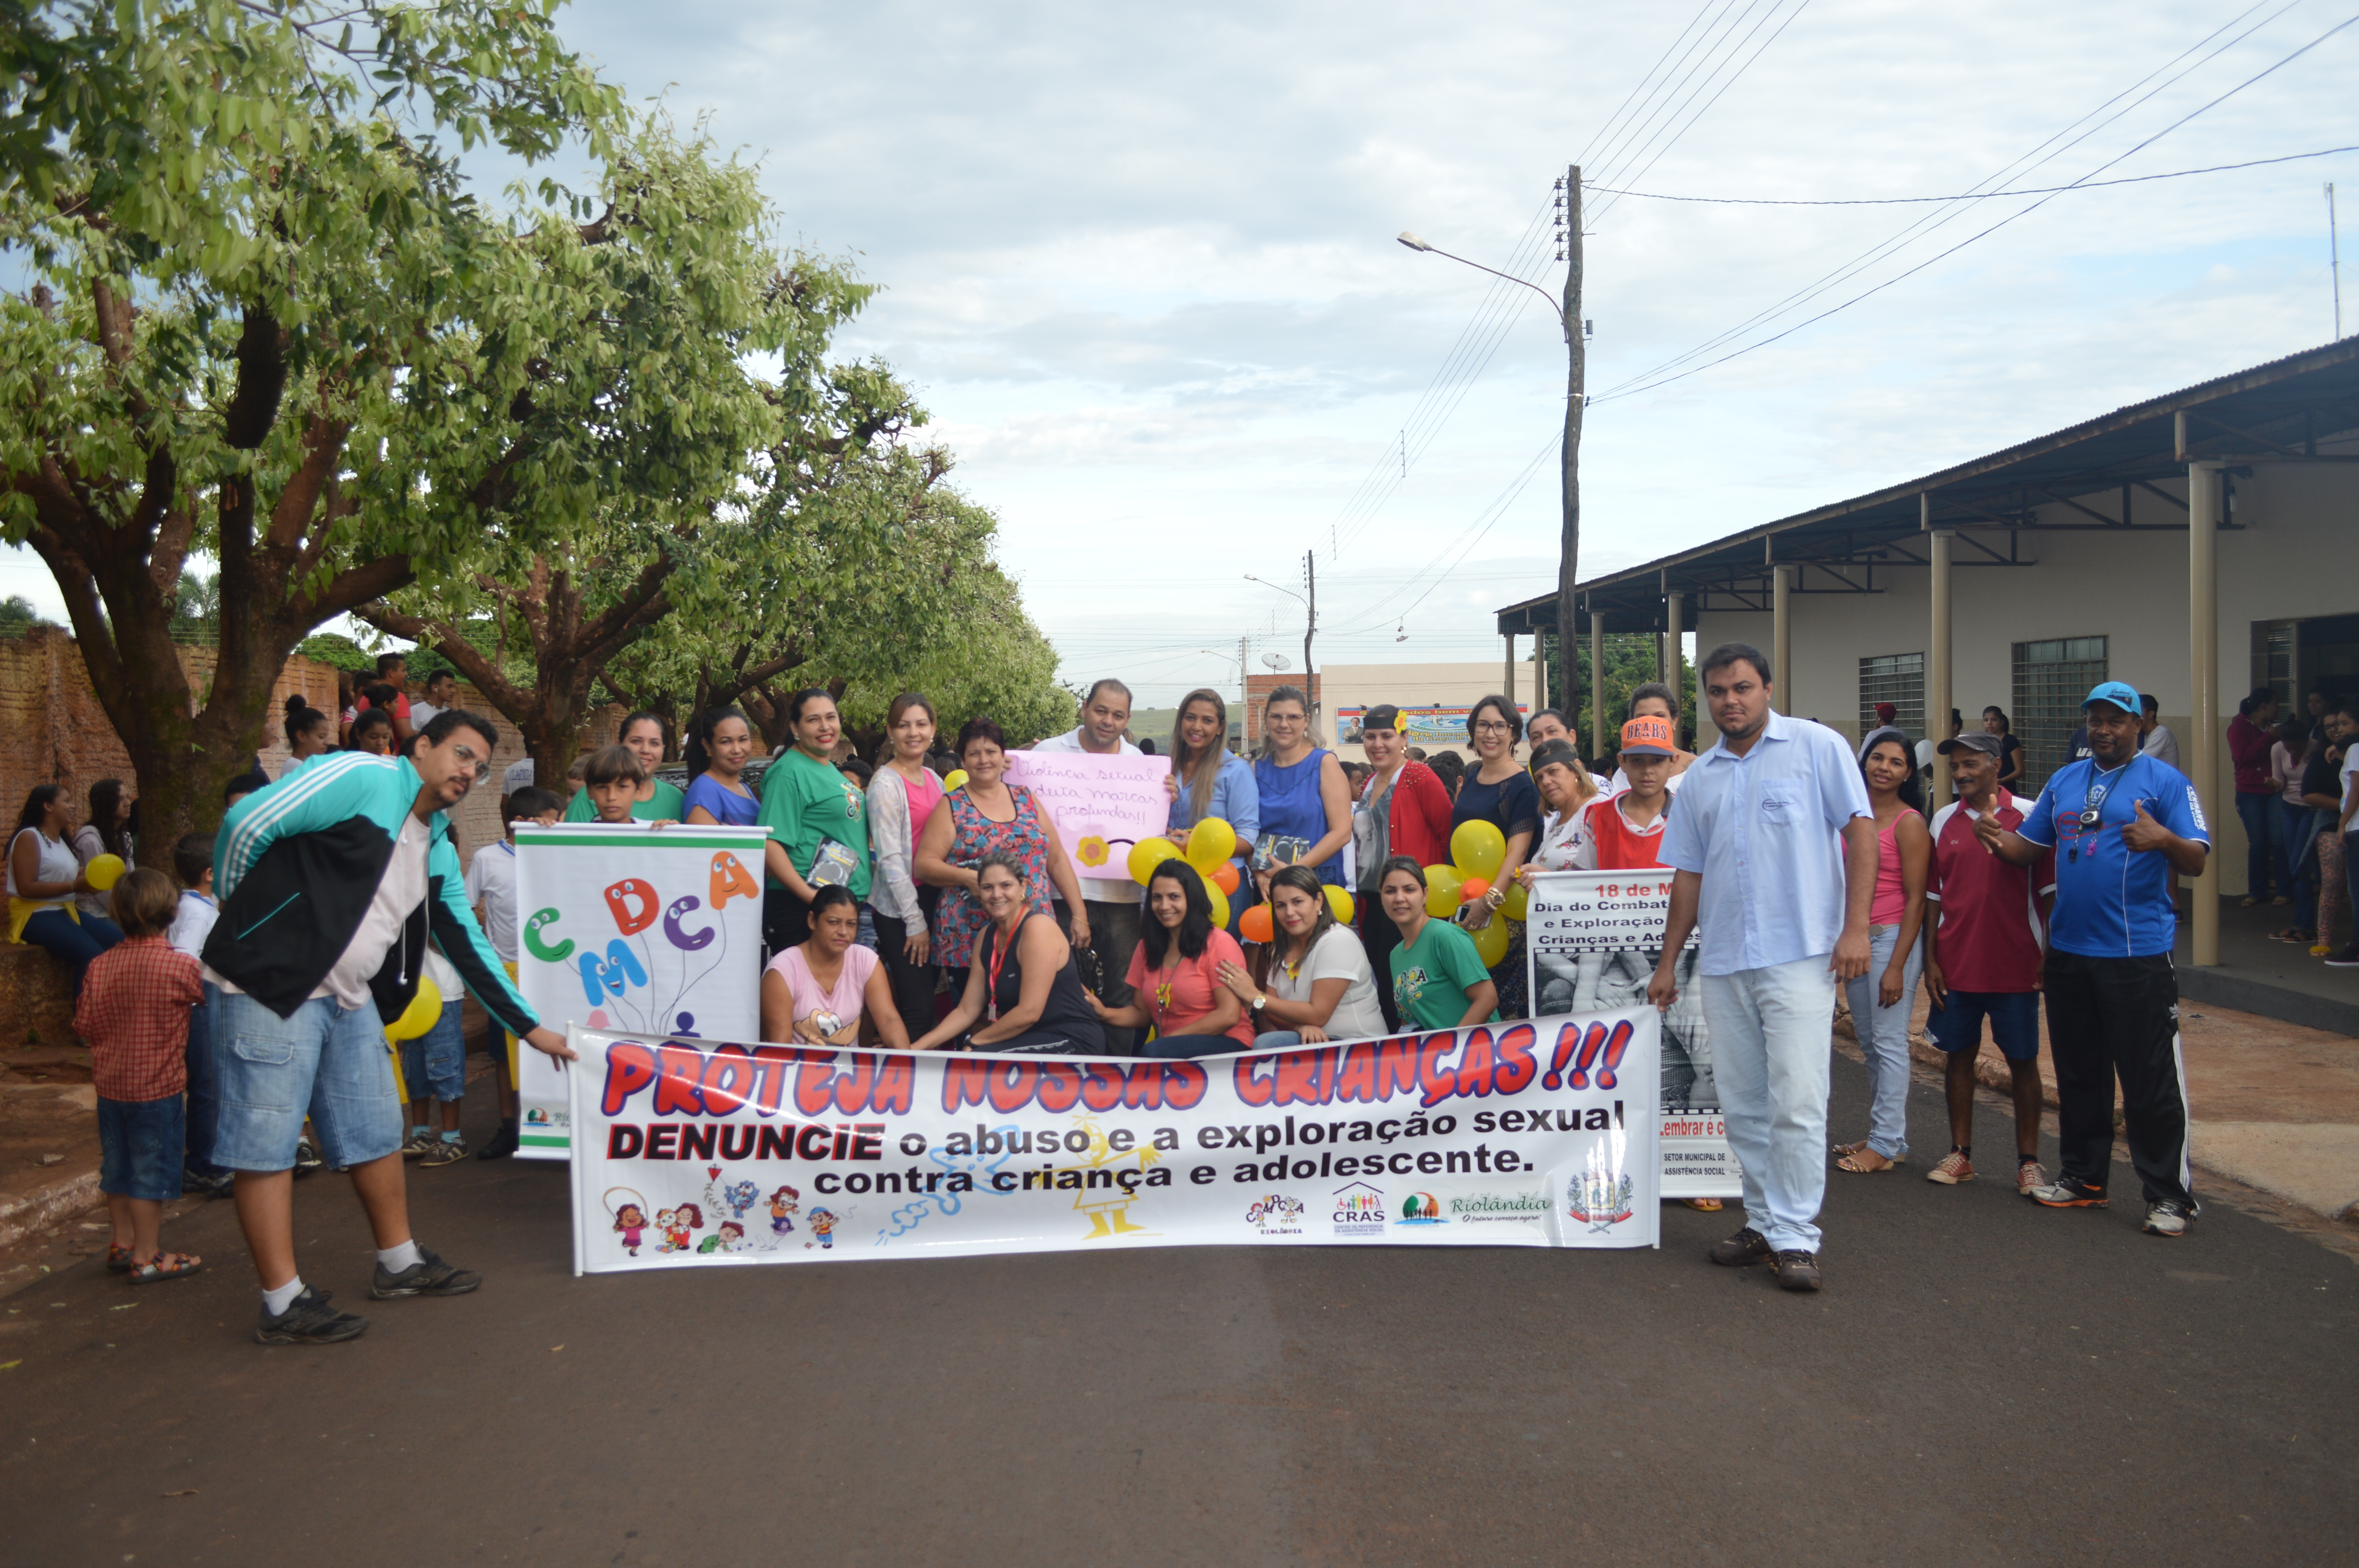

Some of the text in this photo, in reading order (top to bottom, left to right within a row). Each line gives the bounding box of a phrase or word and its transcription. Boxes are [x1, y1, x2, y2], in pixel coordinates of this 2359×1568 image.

[1408, 729, 1433, 737] Igreja
[1626, 722, 1667, 741] BEARS
[1016, 757, 1158, 782] Violência sexual
[1034, 784, 1158, 805] deixa marcas
[1596, 884, 1619, 897] 18
[1626, 884, 1651, 897] de
[1535, 902, 1563, 912] Dia
[1570, 902, 1591, 911] do
[1544, 916, 1664, 929] e Exploração
[1538, 935, 1619, 946] Crianças
[600, 1039, 916, 1118] PROTEJA
[941, 1055, 1209, 1115] NOSSAS
[606, 1100, 1624, 1160] DENUNCIE o abuso e a exploração sexual
[1660, 1118, 1703, 1136] embrar
[1707, 1116, 1714, 1135] é
[1664, 1153, 1683, 1161] SETOR
[1685, 1153, 1716, 1161] MUNICIPAL
[814, 1143, 1534, 1195] contra criança e adolescente.
[1665, 1166, 1703, 1175] ASSISTÊNCIA
[1451, 1193, 1552, 1213] Riolândia
[1333, 1211, 1385, 1223] CRAS
[1463, 1214, 1470, 1222] O
[1519, 1214, 1542, 1223] agora!
